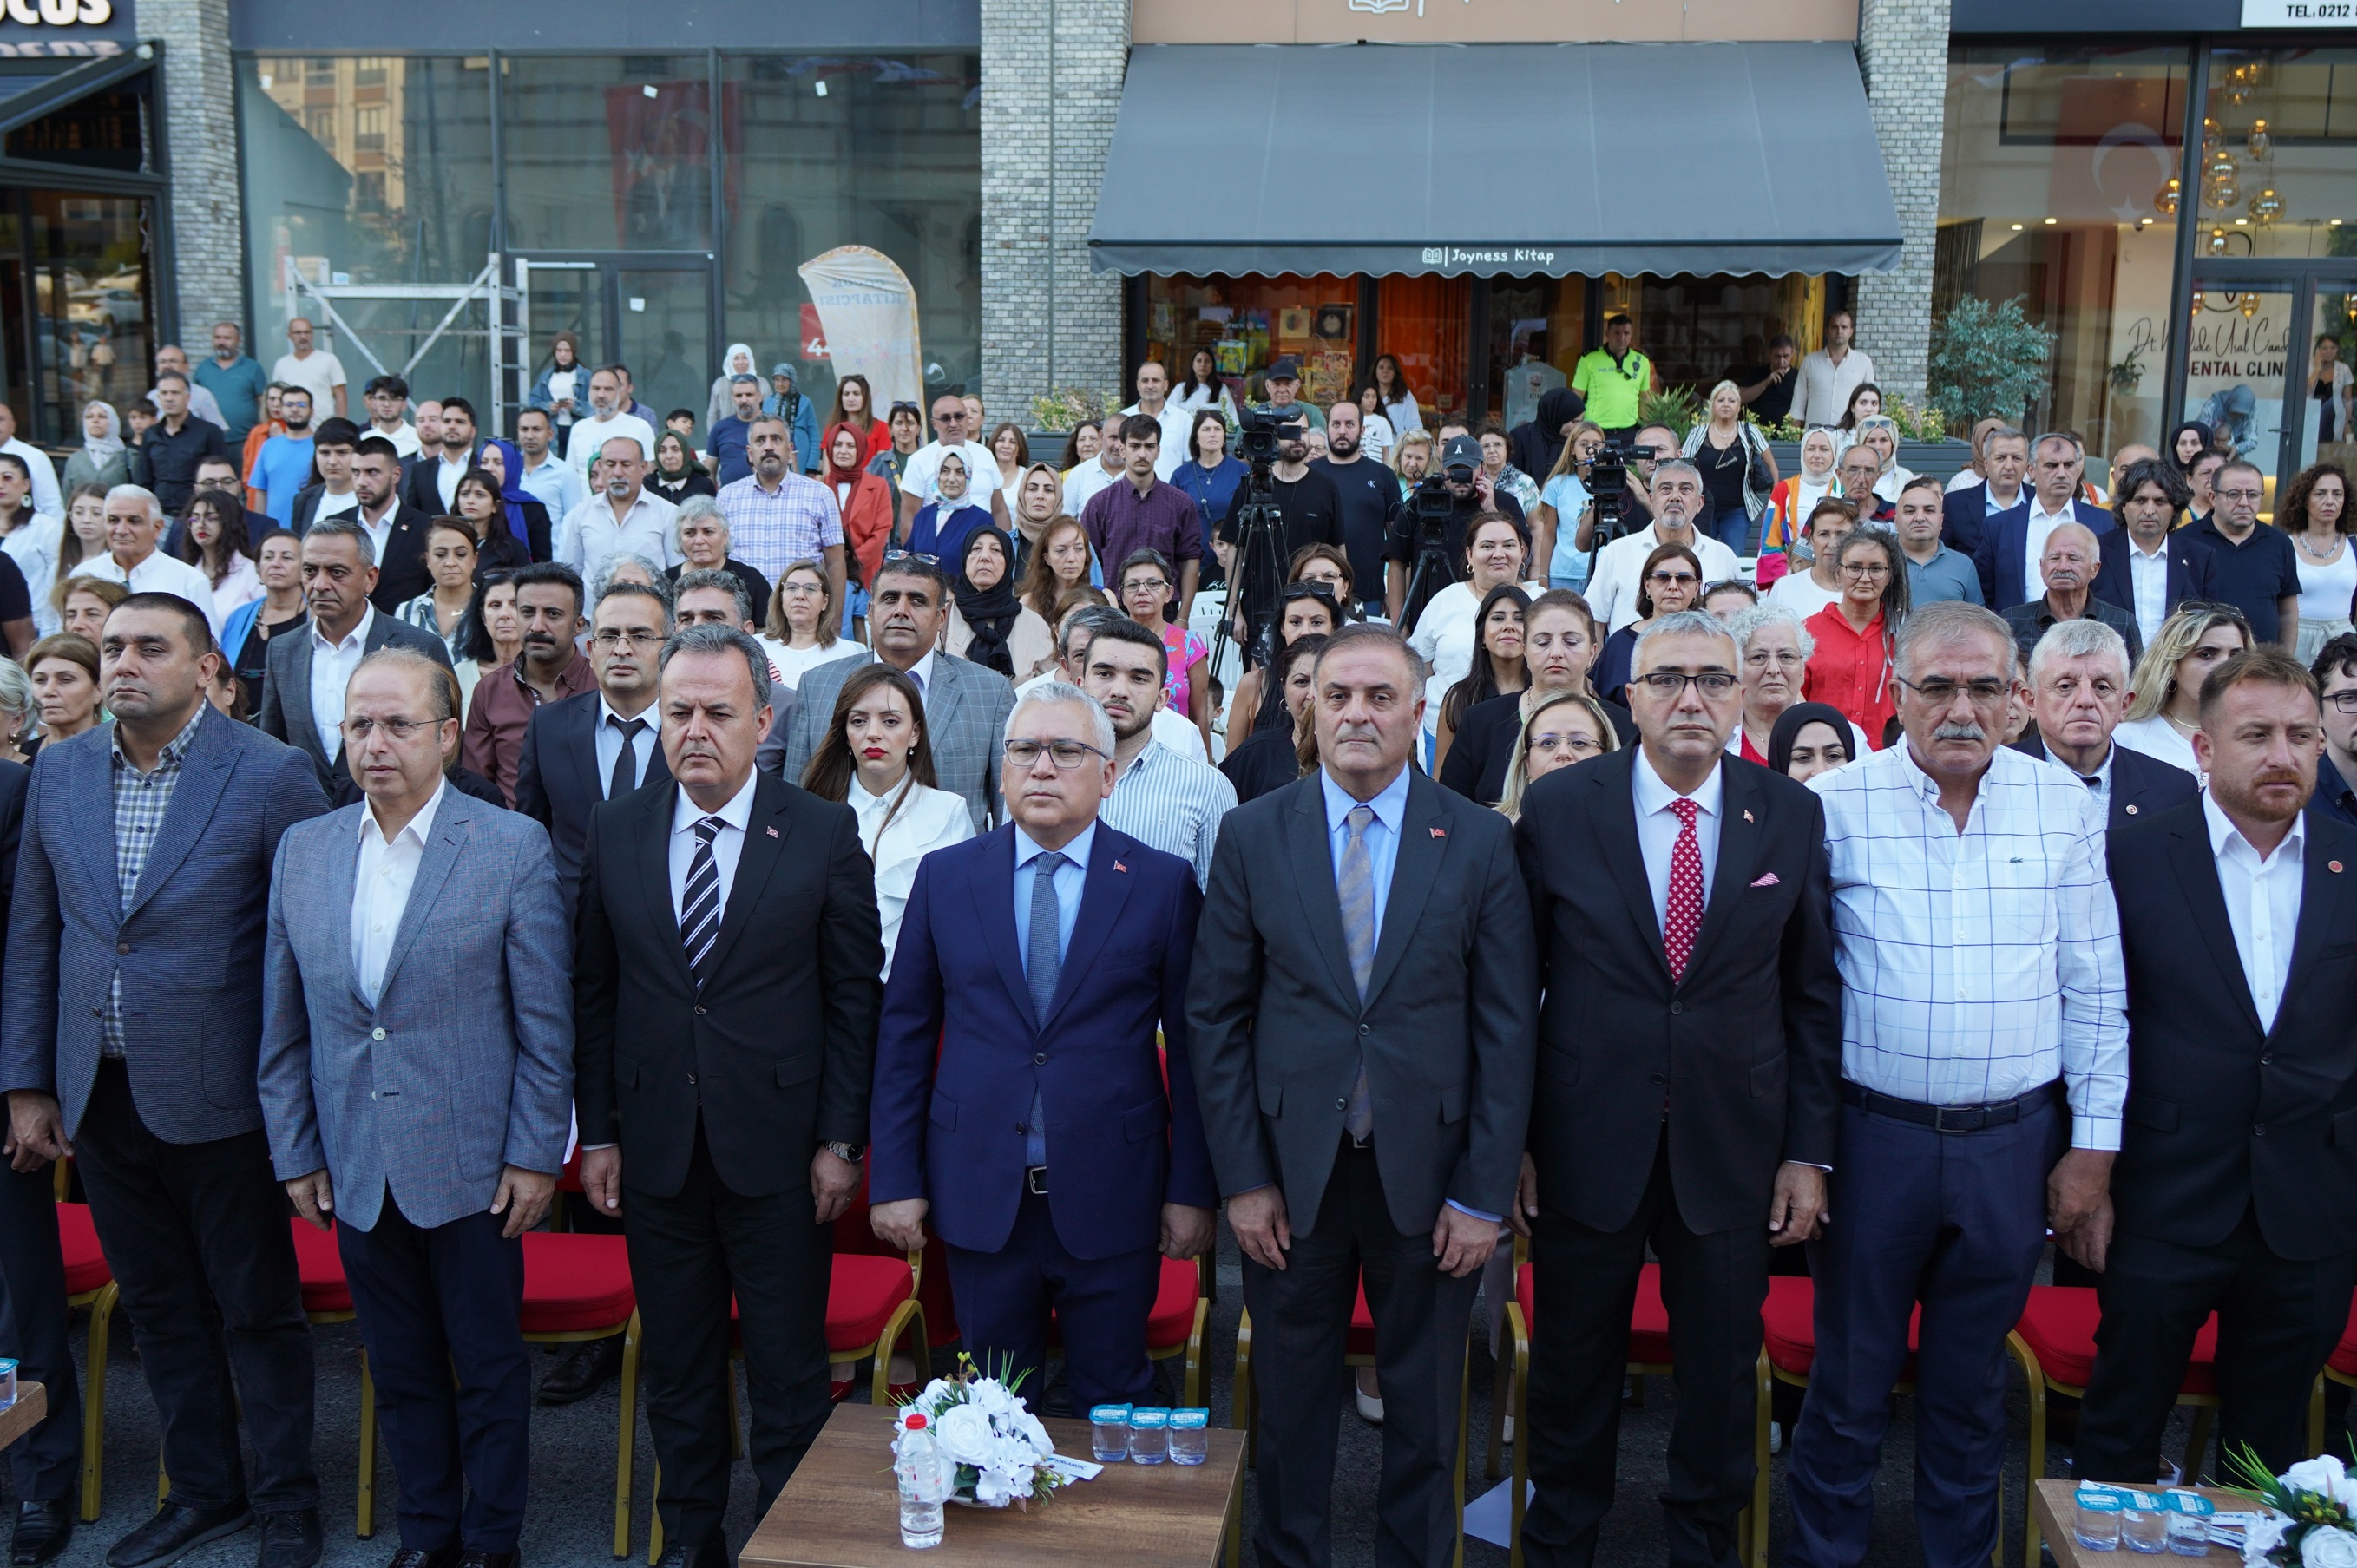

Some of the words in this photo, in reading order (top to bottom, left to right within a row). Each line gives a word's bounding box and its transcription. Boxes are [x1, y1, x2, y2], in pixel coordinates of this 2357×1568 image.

[1451, 248, 1508, 265] Joyness
[1514, 248, 1554, 266] Kitap
[2190, 361, 2241, 377] ENTAL
[2246, 361, 2287, 377] CLIN
[1454, 444, 1463, 454] A
